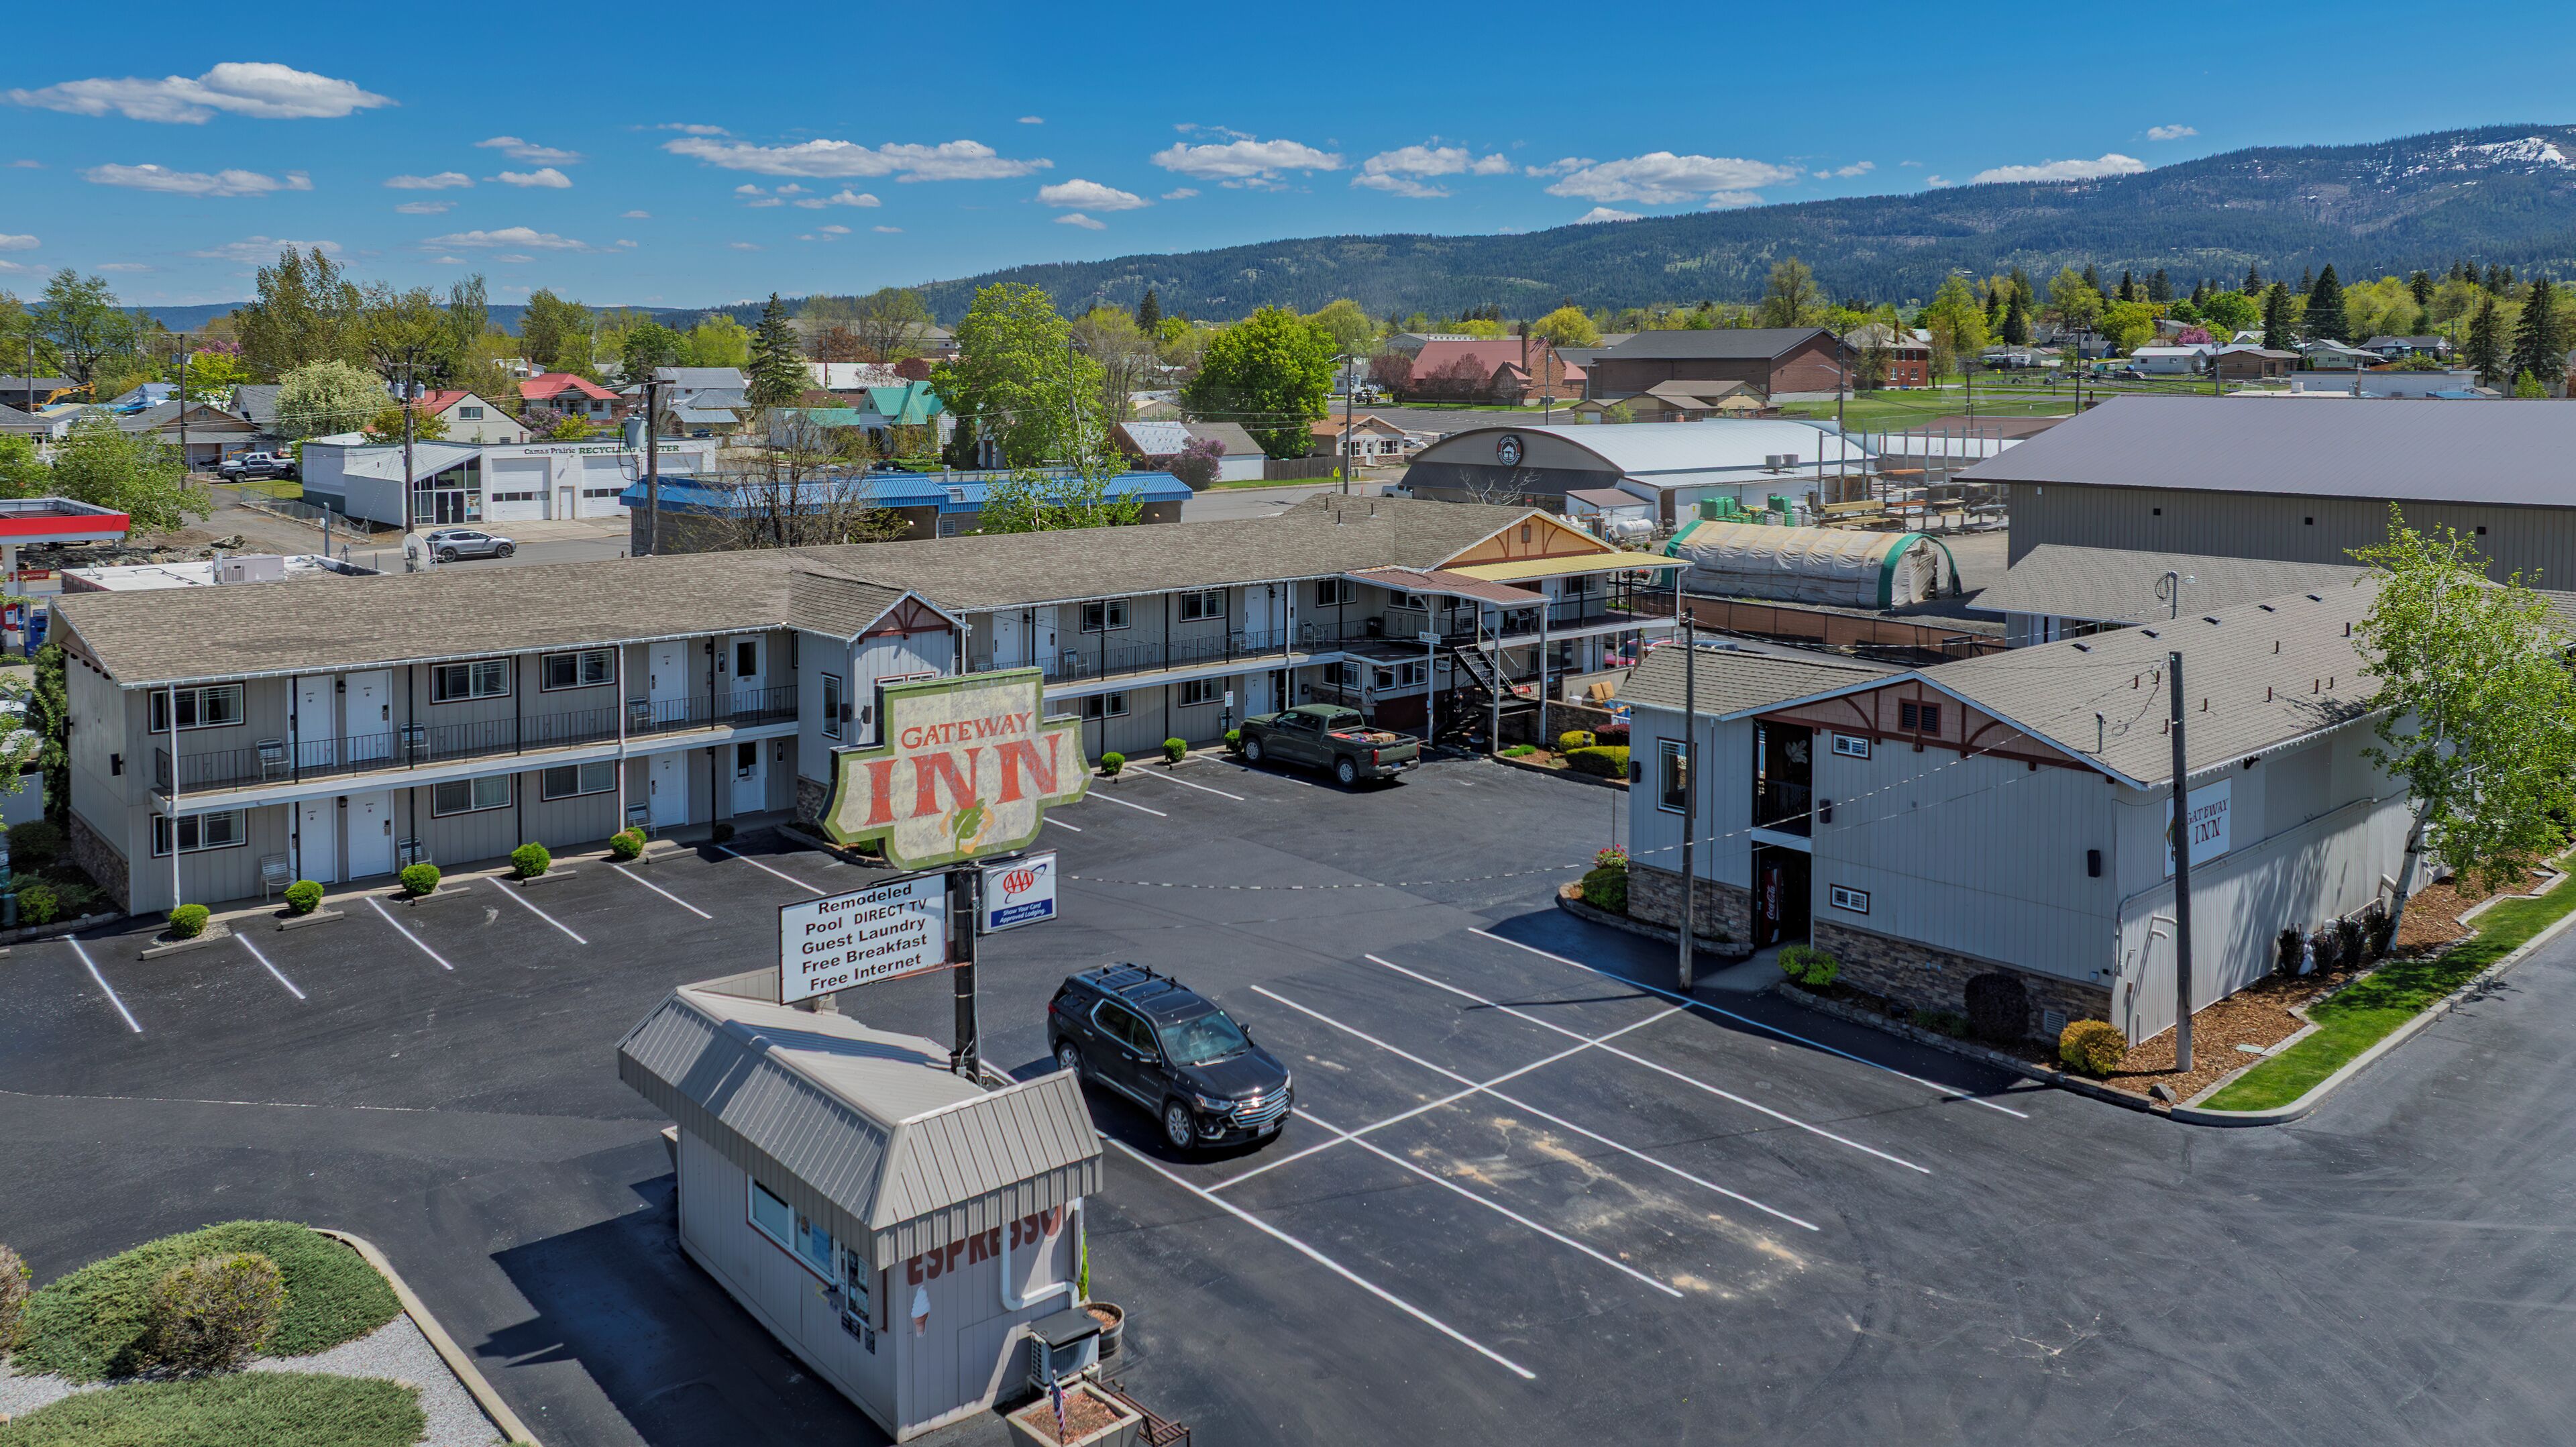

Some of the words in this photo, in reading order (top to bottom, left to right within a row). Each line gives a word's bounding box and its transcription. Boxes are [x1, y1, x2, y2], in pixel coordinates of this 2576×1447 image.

[579, 446, 636, 454] RECYCLING
[901, 712, 1033, 749] GATEWAY
[863, 733, 1063, 826] INN
[2195, 816, 2222, 845] INN
[1004, 869, 1033, 893] AAA
[818, 883, 912, 914] Remodeled
[1003, 908, 1017, 916] Show
[1030, 902, 1042, 910] Card
[806, 917, 843, 935] Pool
[854, 903, 905, 924] DIRECT
[909, 898, 927, 912] TV
[1000, 912, 1024, 924] Approved
[802, 932, 853, 955] Guest
[859, 918, 926, 942] Laundry
[802, 957, 840, 974] Free
[847, 933, 927, 963] Breakfast
[810, 973, 848, 991] Free
[854, 953, 921, 980] Internet
